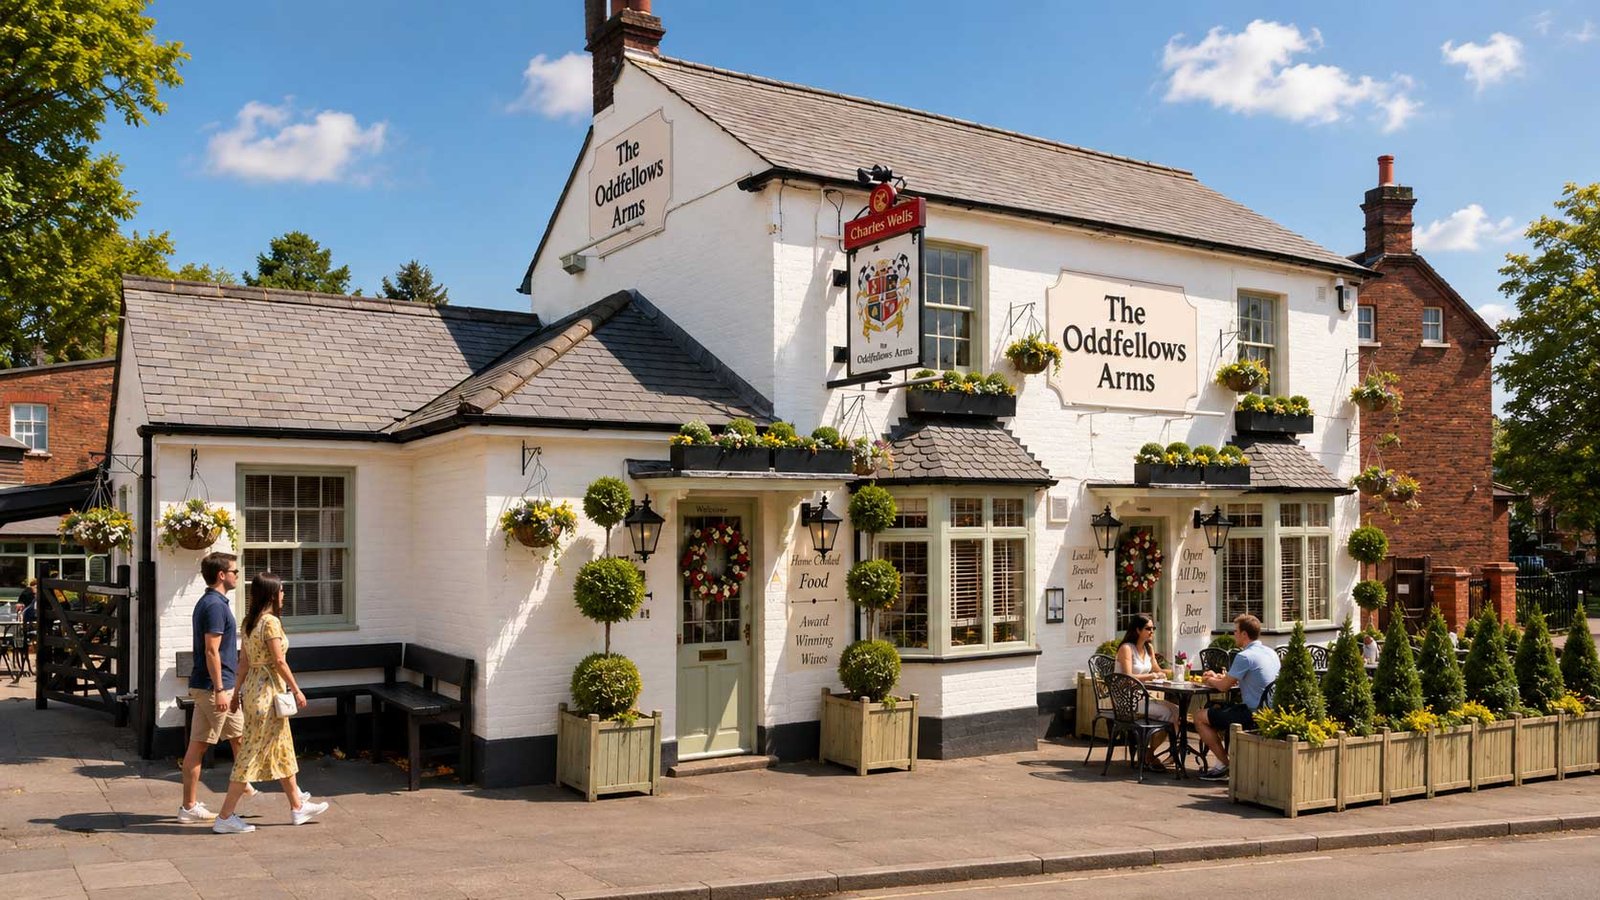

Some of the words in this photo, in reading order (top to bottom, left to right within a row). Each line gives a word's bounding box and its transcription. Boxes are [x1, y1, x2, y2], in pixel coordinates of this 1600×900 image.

[616, 139, 640, 167] The
[595, 159, 664, 207] Oddfellows
[611, 199, 645, 229] Arms
[850, 220, 885, 240] Charles
[887, 209, 913, 228] Wells
[1104, 294, 1146, 325] The
[1062, 324, 1187, 363] Oddfellows
[894, 347, 913, 358] Arms
[1097, 362, 1155, 393] Arms
[791, 554, 812, 566] Home
[1072, 549, 1097, 563] Locally
[1183, 548, 1204, 565] Open
[1072, 564, 1099, 575] Brewed
[1178, 567, 1190, 580] All
[799, 571, 830, 589] Food
[1077, 579, 1094, 590] Ales
[1185, 603, 1202, 617] Beer
[799, 613, 830, 628] Award
[1074, 612, 1097, 629] Open
[1179, 620, 1207, 635] Garden
[795, 633, 834, 649] Winning
[1077, 630, 1095, 644] Fire
[801, 652, 828, 665] Wines
